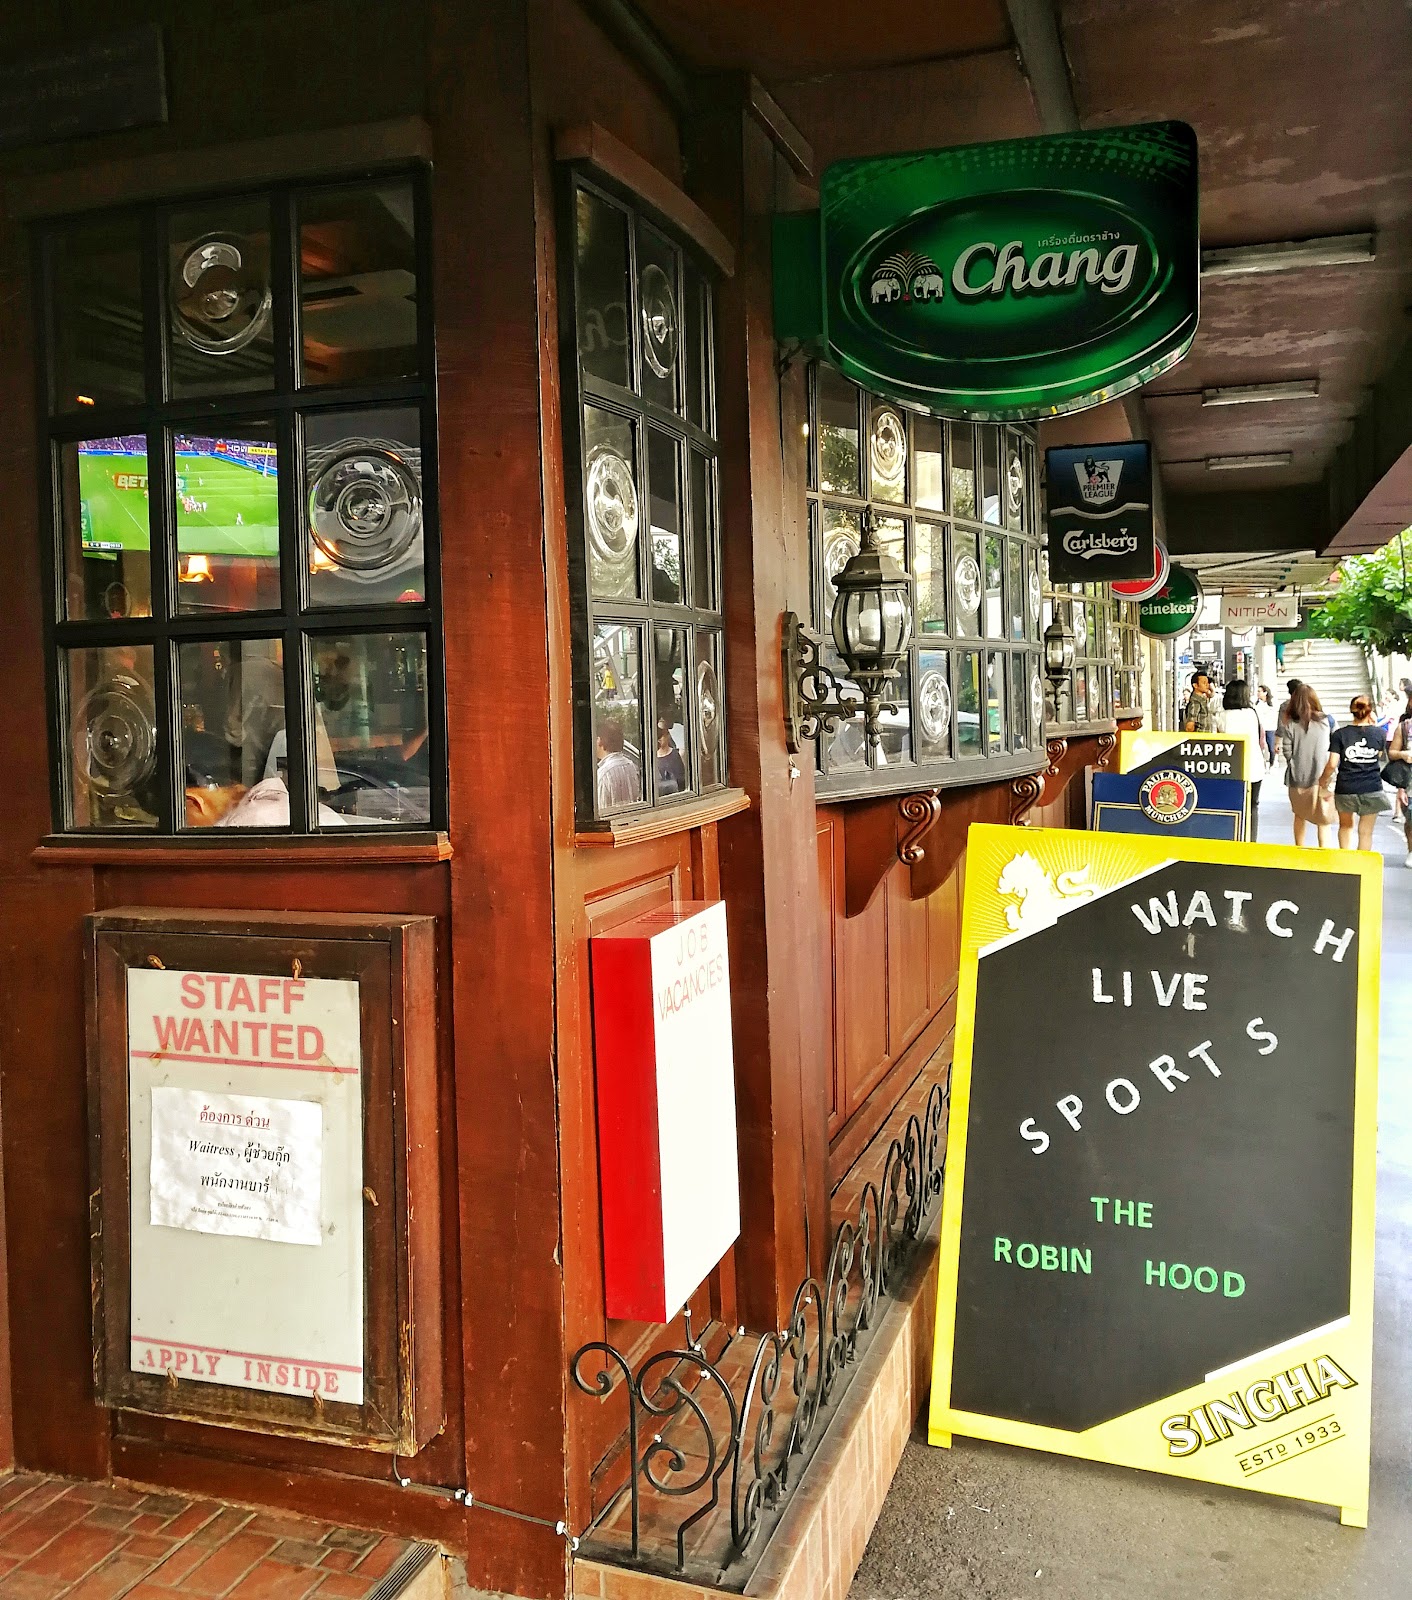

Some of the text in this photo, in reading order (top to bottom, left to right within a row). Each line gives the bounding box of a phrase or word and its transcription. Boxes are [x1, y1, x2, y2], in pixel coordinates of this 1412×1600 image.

[952, 239, 1139, 297] Chang
[1083, 482, 1116, 492] PREMIER
[1084, 489, 1115, 499] LEAGUE
[1062, 528, 1138, 560] Carlsberg
[1140, 602, 1196, 616] eineken
[1180, 743, 1235, 757] HAPPY
[1184, 760, 1231, 775] HOUR
[1142, 772, 1193, 795] PAULANER
[677, 923, 708, 967] JOB
[1131, 889, 1356, 963] WATCH
[180, 973, 306, 1015] STAFF
[658, 953, 723, 1022] VACANCIES
[1092, 967, 1209, 1011] LIVE
[152, 1014, 325, 1061] WANTED
[1019, 1016, 1279, 1155] SPORTS
[199, 1104, 270, 1128] ต้องการ ด่วน
[200, 1171, 270, 1194] พนักงานบาร์
[1090, 1196, 1154, 1229] THE
[993, 1237, 1092, 1275] ROBIN
[1145, 1260, 1246, 1298] HOOD
[139, 1348, 339, 1393] APPLY INSIDE
[1160, 1354, 1359, 1457] SINGHA
[1295, 1420, 1343, 1449] 1933
